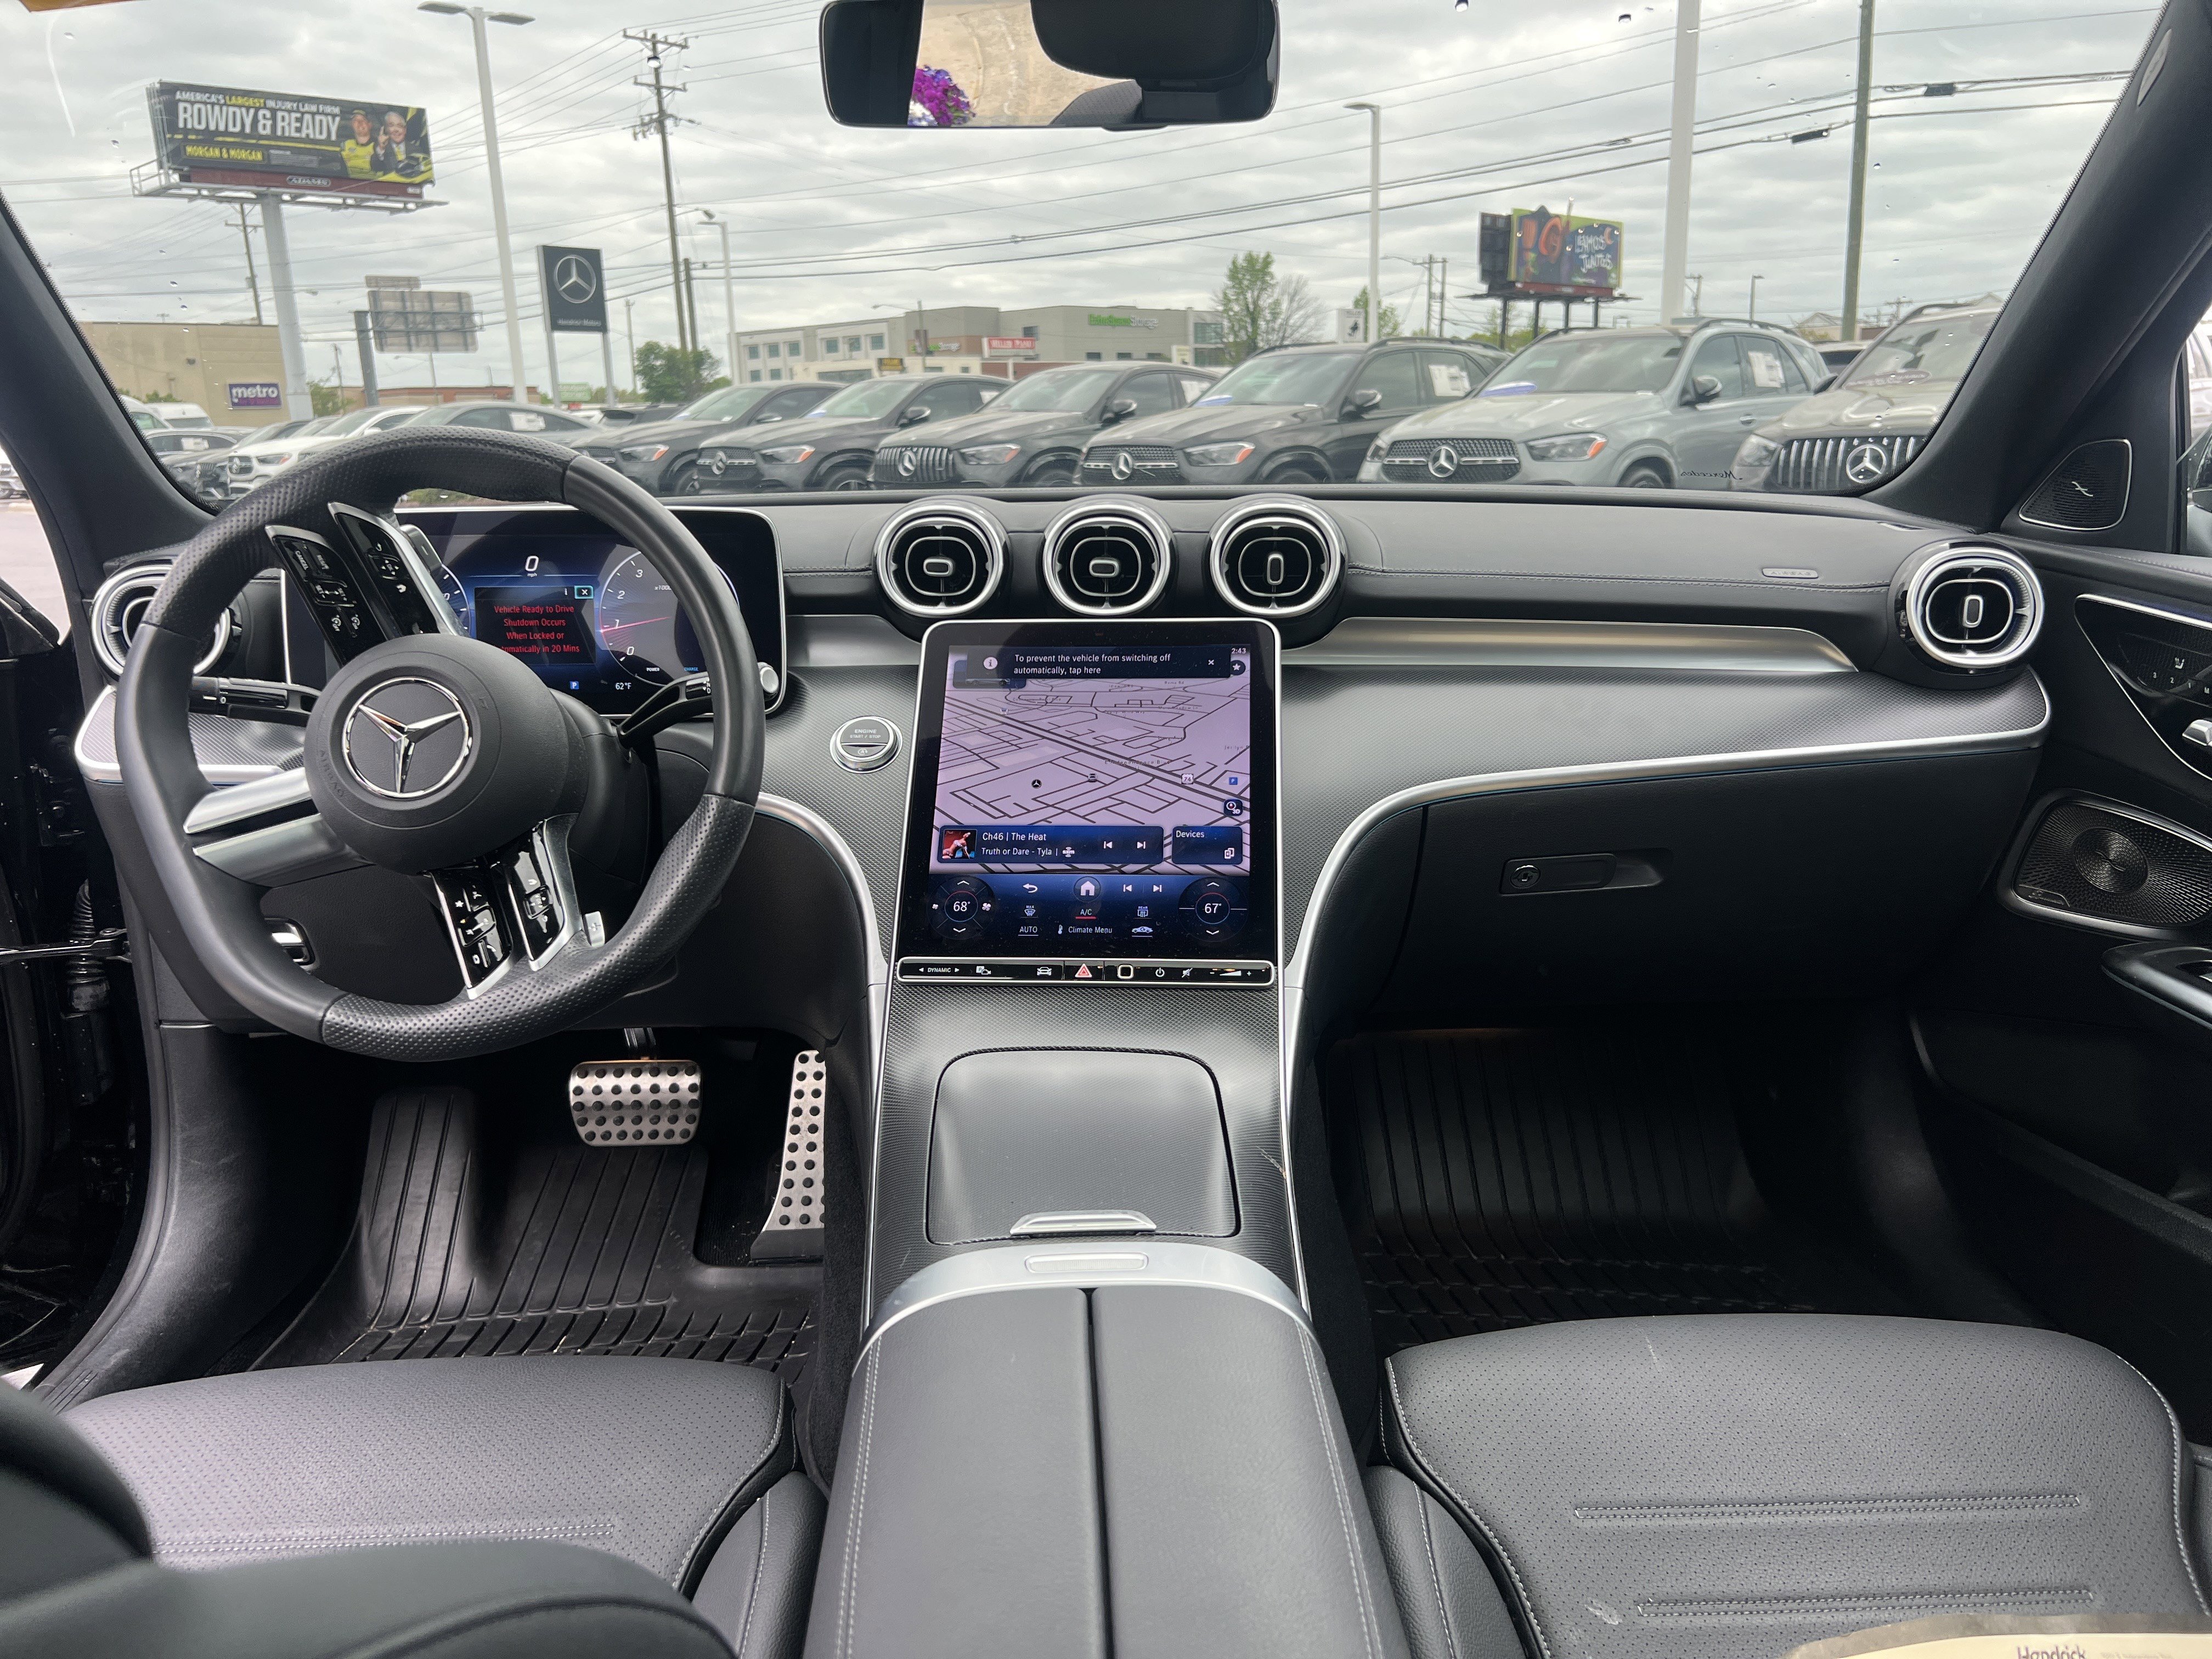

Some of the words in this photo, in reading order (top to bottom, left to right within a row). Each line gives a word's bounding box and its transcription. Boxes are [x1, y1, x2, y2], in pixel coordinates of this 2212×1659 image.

[176, 91, 224, 104] AMERICA'S
[225, 95, 265, 107] LARGEST
[266, 99, 298, 110] INJURY
[299, 102, 318, 113] LAW
[178, 101, 255, 133] ROWDY
[257, 109, 273, 135] &
[276, 110, 341, 141] READY
[185, 145, 221, 159] MORGAN
[221, 148, 229, 159] &
[229, 148, 264, 161] MORGAN
[232, 385, 278, 403] metro
[525, 555, 539, 571] 0
[635, 569, 643, 578] 3
[617, 590, 625, 599] 2
[522, 605, 544, 614] Ready
[555, 605, 574, 613] Drive
[504, 618, 539, 627] Shutdown
[614, 619, 620, 629] 1
[552, 644, 561, 653] 20
[563, 644, 580, 653] Mins
[626, 646, 635, 656] 0
[1026, 655, 1056, 663] prevent
[1101, 654, 1119, 662] from
[1121, 653, 1158, 663] switching
[1159, 653, 1171, 662] off
[1014, 666, 1067, 675] automatically,
[1069, 667, 1082, 675] tap
[982, 832, 1004, 841] Ch46
[1011, 832, 1026, 841] The
[1028, 833, 1047, 841] Heat
[1037, 848, 1052, 857] Tyla
